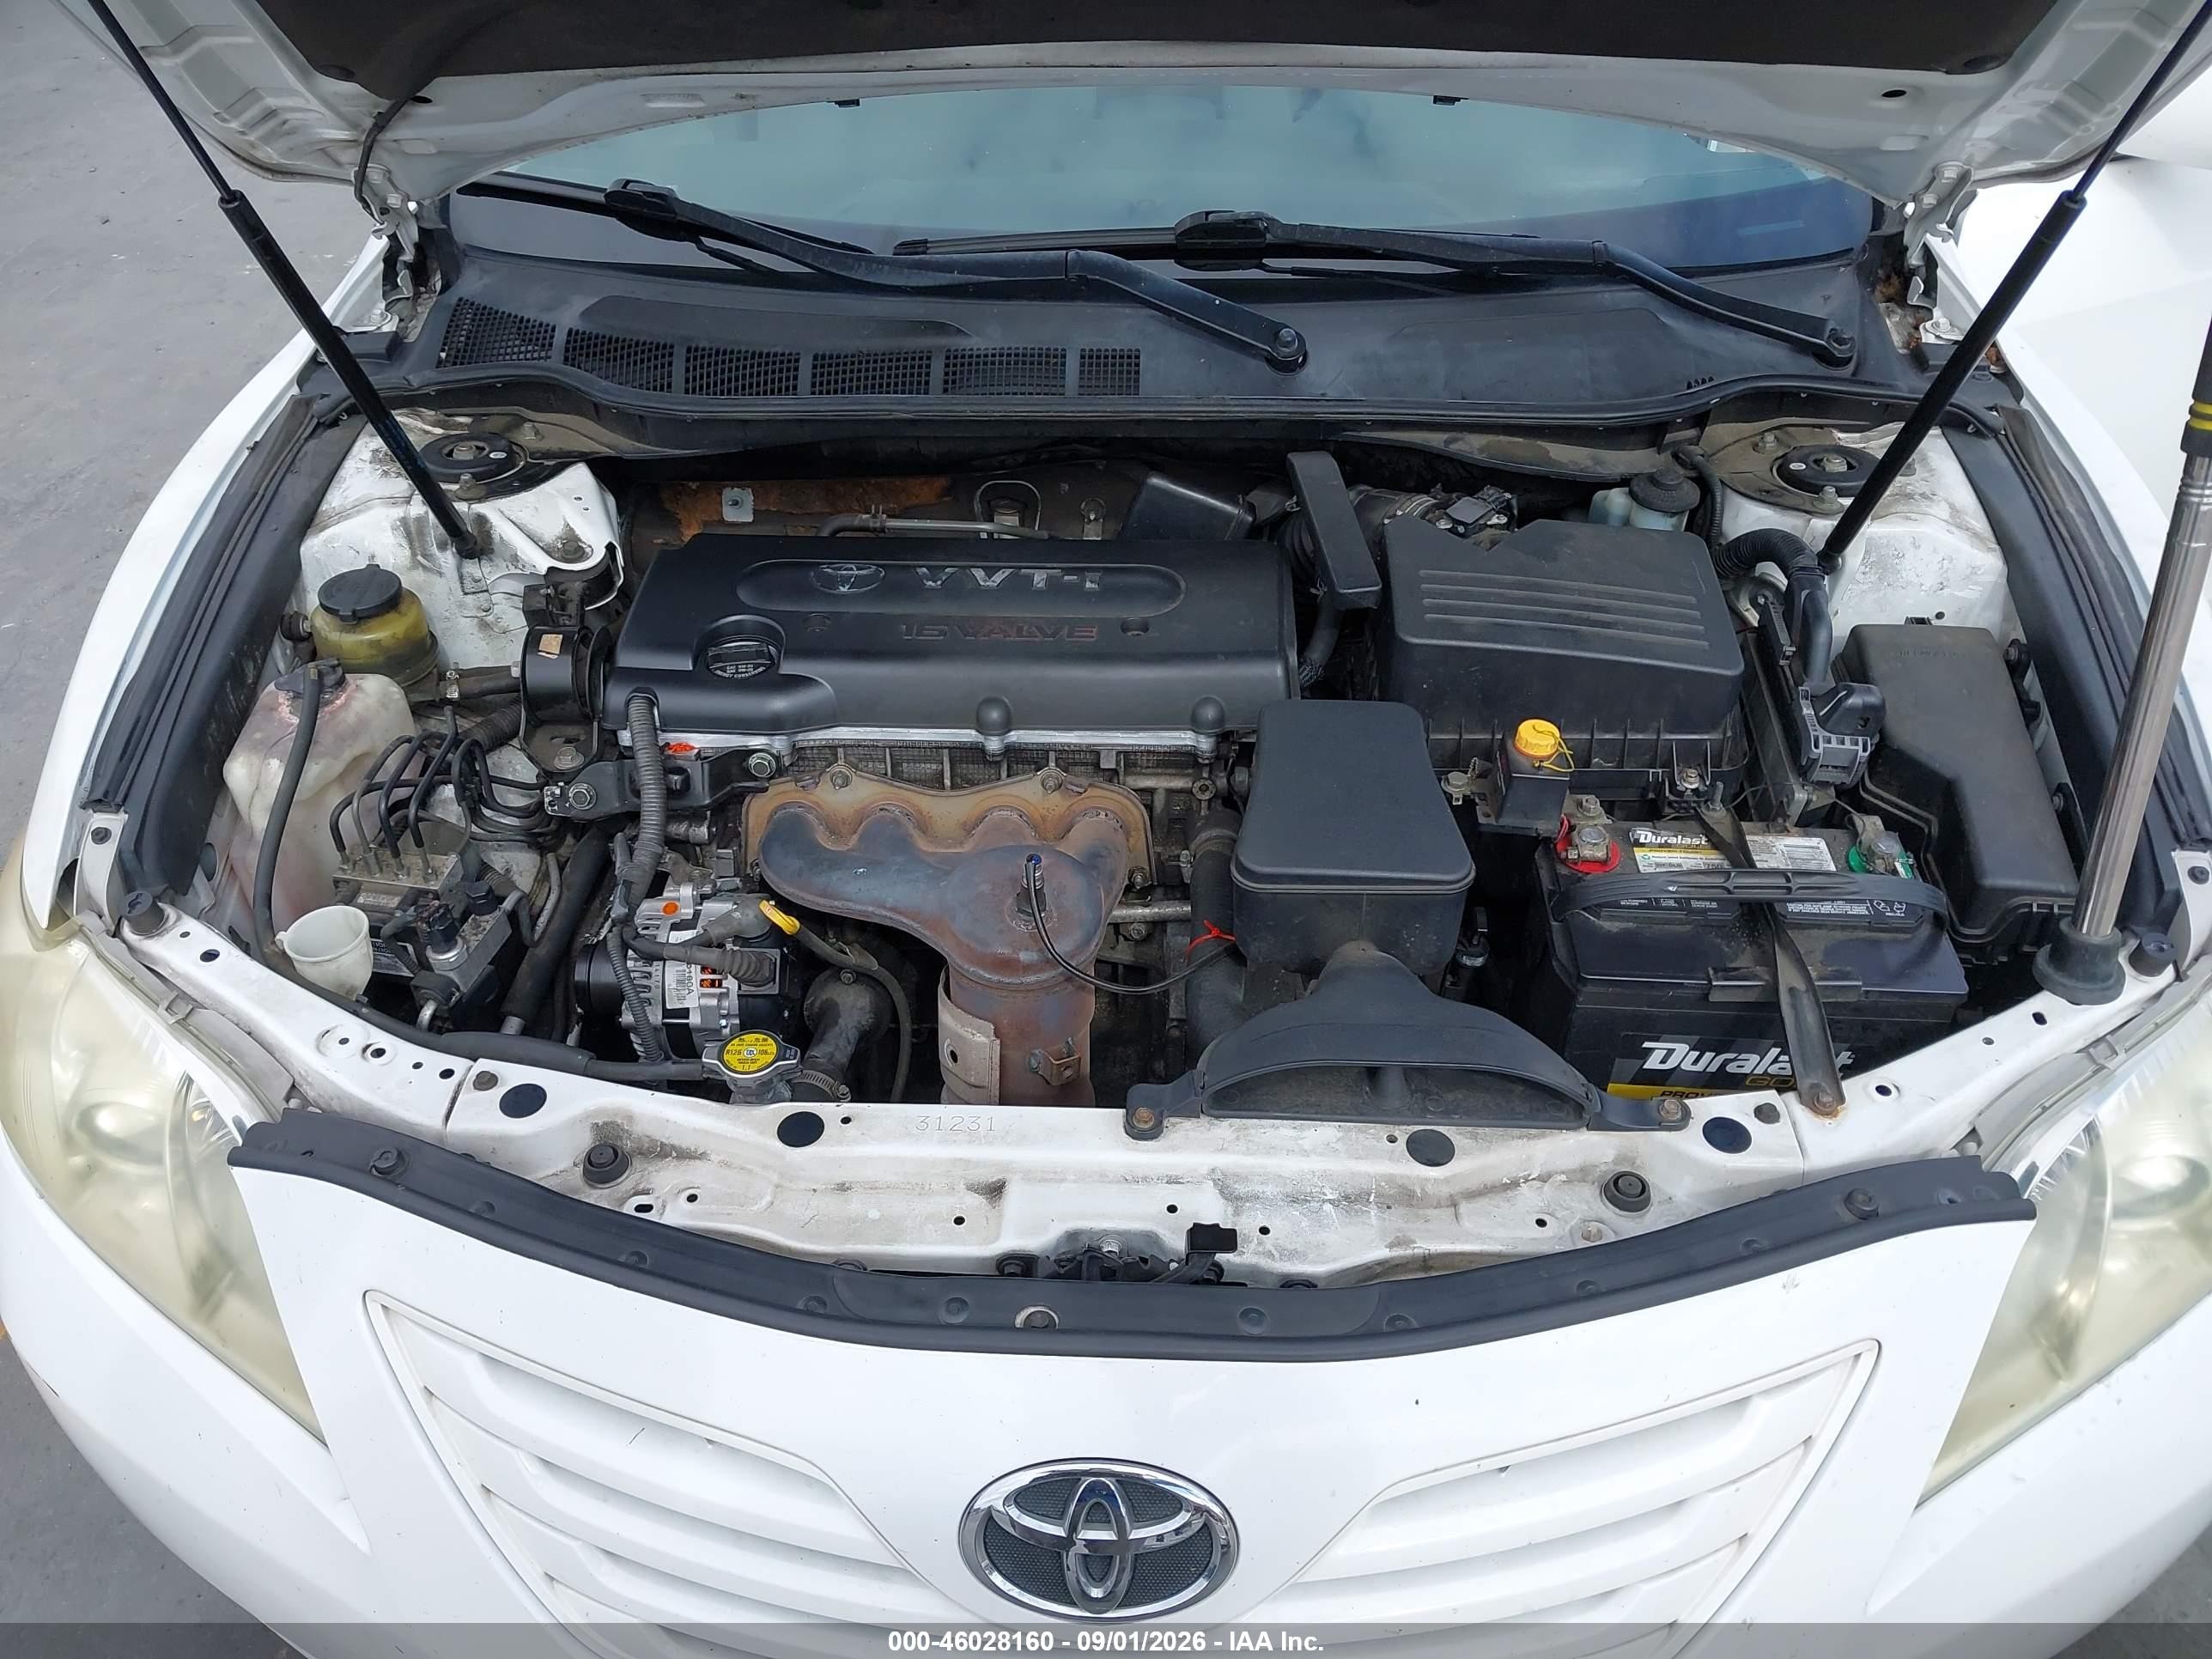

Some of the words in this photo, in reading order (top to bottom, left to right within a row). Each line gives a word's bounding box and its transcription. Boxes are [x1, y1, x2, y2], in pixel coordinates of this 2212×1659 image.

[901, 624, 949, 641] 16
[954, 623, 1098, 641] VALVE
[1636, 830, 1709, 845] Duralast
[1641, 1041, 1856, 1078] Duralat
[1745, 1075, 1795, 1088] GO
[915, 1115, 996, 1133] 31231
